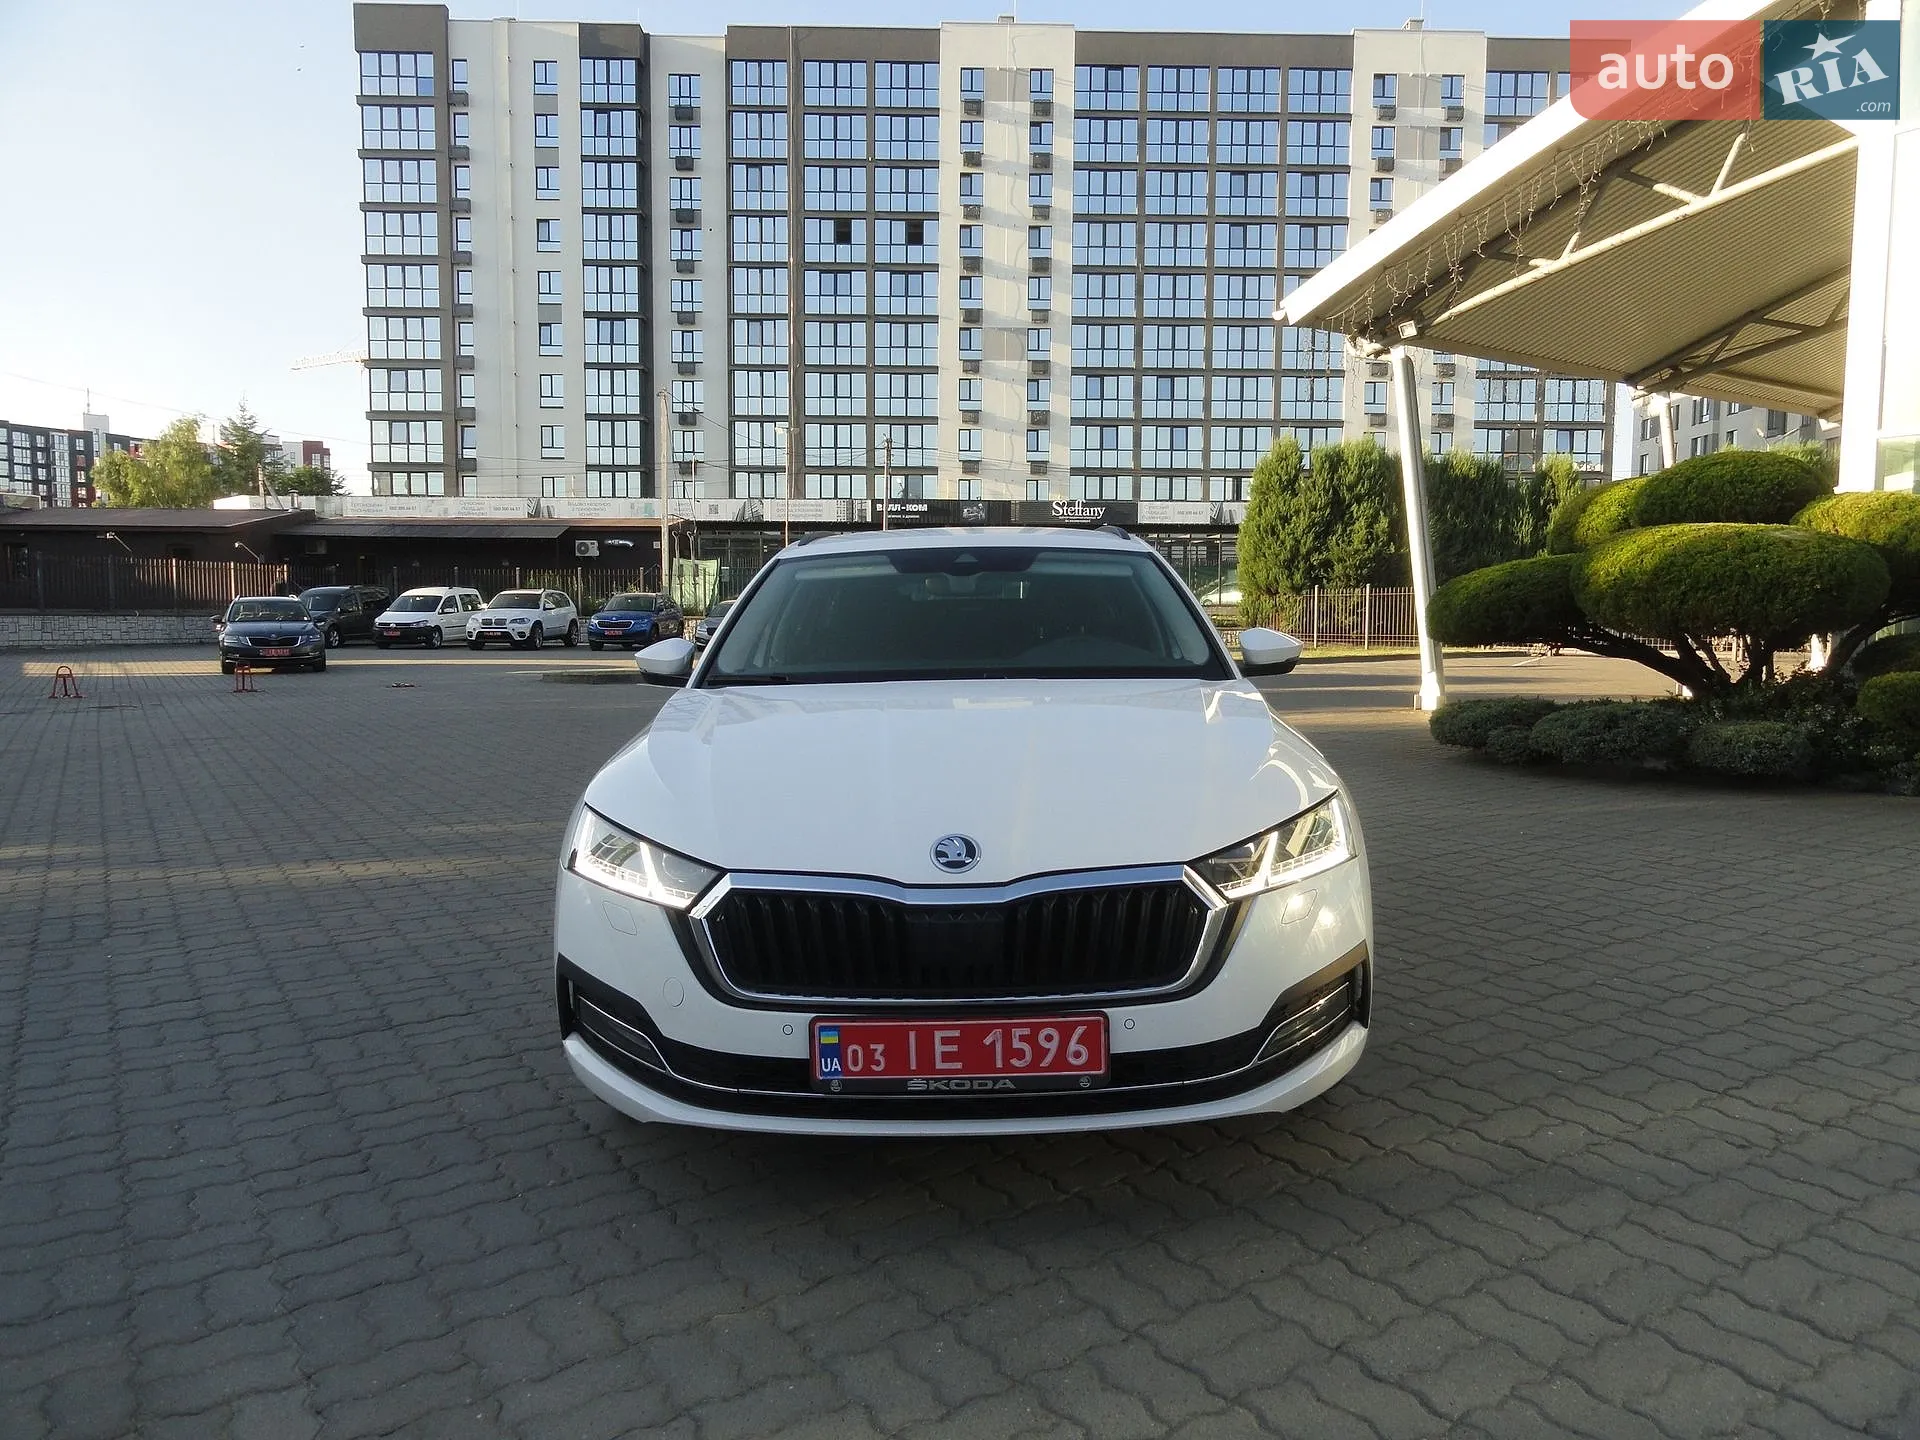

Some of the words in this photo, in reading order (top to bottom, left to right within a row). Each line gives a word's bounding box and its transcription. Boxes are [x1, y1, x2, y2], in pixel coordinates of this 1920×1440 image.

[876, 503, 928, 512] ВЛЛ-КОМ
[1051, 499, 1105, 518] Steffany
[847, 1043, 886, 1072] 03
[908, 1030, 963, 1070] IE
[983, 1025, 1090, 1069] 1596
[821, 1058, 842, 1073] UA
[907, 1078, 1017, 1091] ŠKODA
